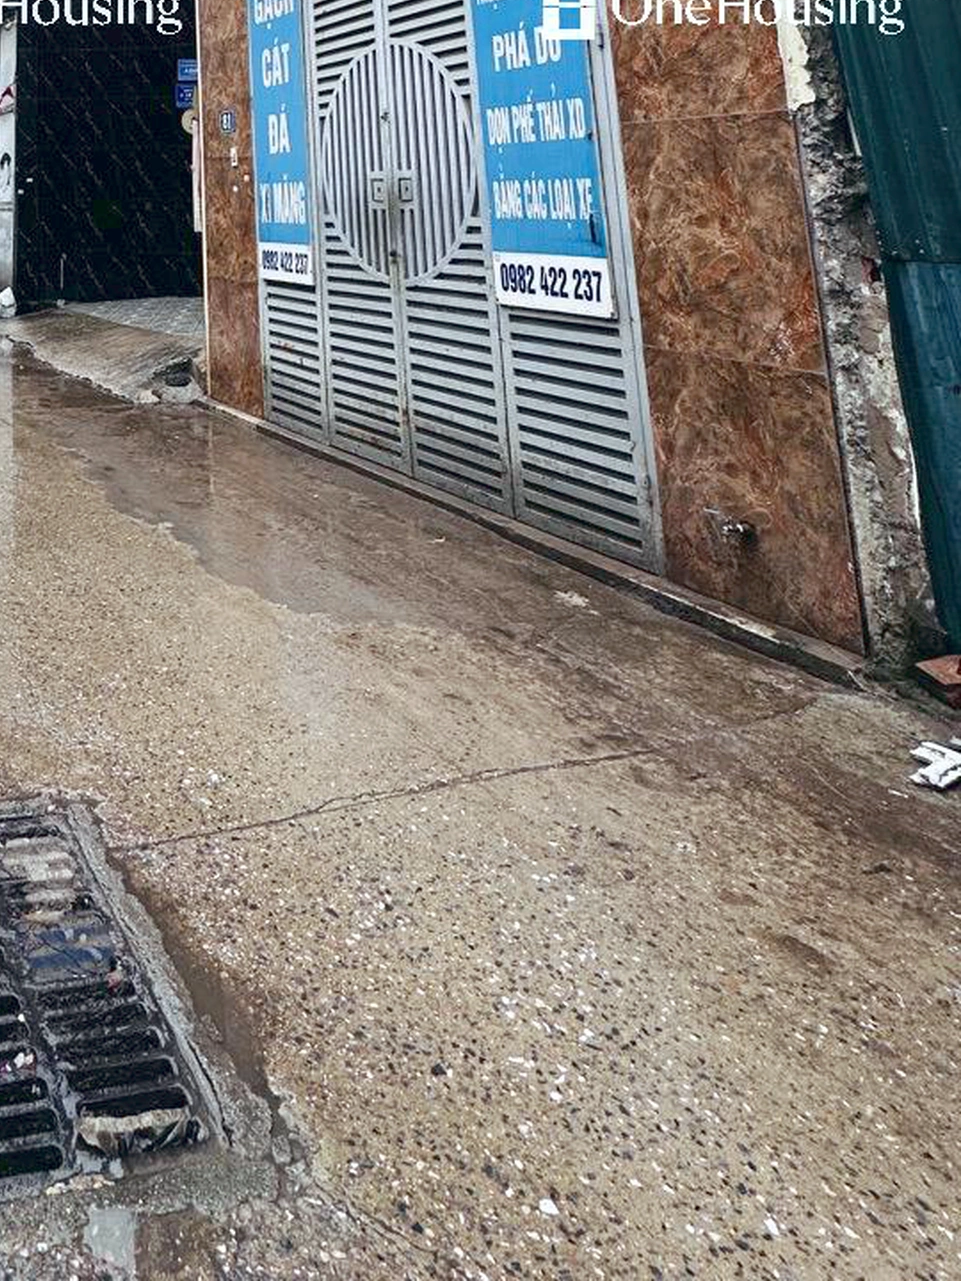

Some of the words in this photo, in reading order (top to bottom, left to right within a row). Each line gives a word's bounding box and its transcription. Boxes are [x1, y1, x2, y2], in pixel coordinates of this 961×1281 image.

[261, 37, 290, 88] CÁT
[492, 21, 531, 72] PHÁ
[268, 103, 291, 155] ĐÁ
[486, 106, 511, 154] DỌN
[511, 88, 537, 144] PHẾ
[536, 82, 565, 142] THẢI
[565, 97, 587, 140] XD
[259, 182, 272, 224] XI
[523, 171, 548, 220] CÁC
[547, 178, 576, 229] LOẠI
[575, 177, 593, 221] XE
[500, 262, 536, 295] 0982
[540, 266, 569, 299] 422
[573, 268, 602, 302] 237
